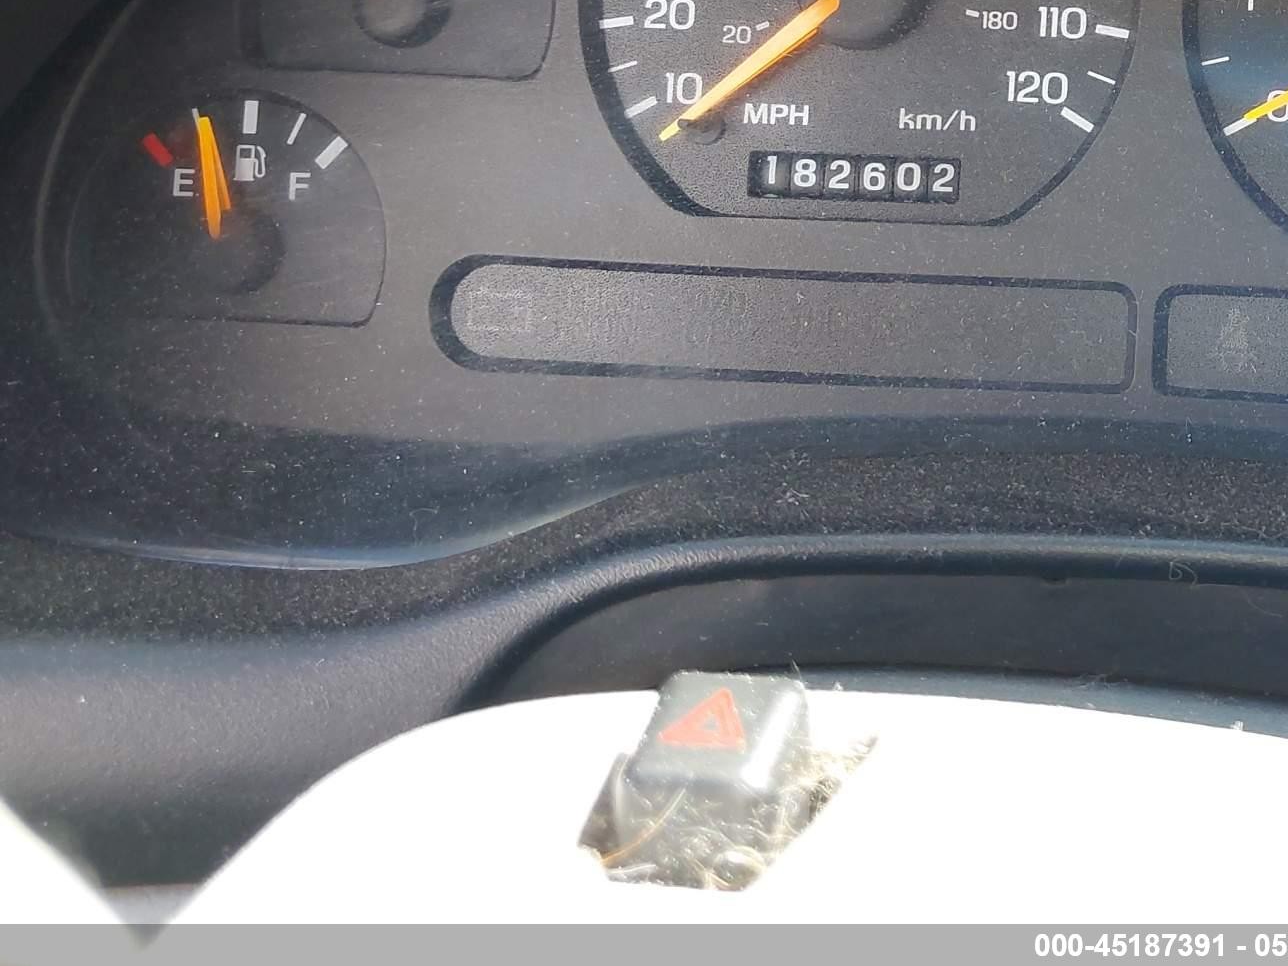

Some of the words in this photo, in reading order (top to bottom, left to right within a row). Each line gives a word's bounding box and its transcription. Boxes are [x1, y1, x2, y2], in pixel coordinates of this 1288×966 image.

[723, 25, 751, 43] 20
[983, 11, 1017, 30] 180
[1039, 7, 1086, 39] 110
[664, 70, 705, 105] 10
[1007, 71, 1068, 104] 120
[744, 103, 809, 125] MPH
[899, 108, 975, 131] km/h
[173, 169, 195, 196] E
[289, 173, 310, 200] F
[765, 155, 956, 194] 182602
